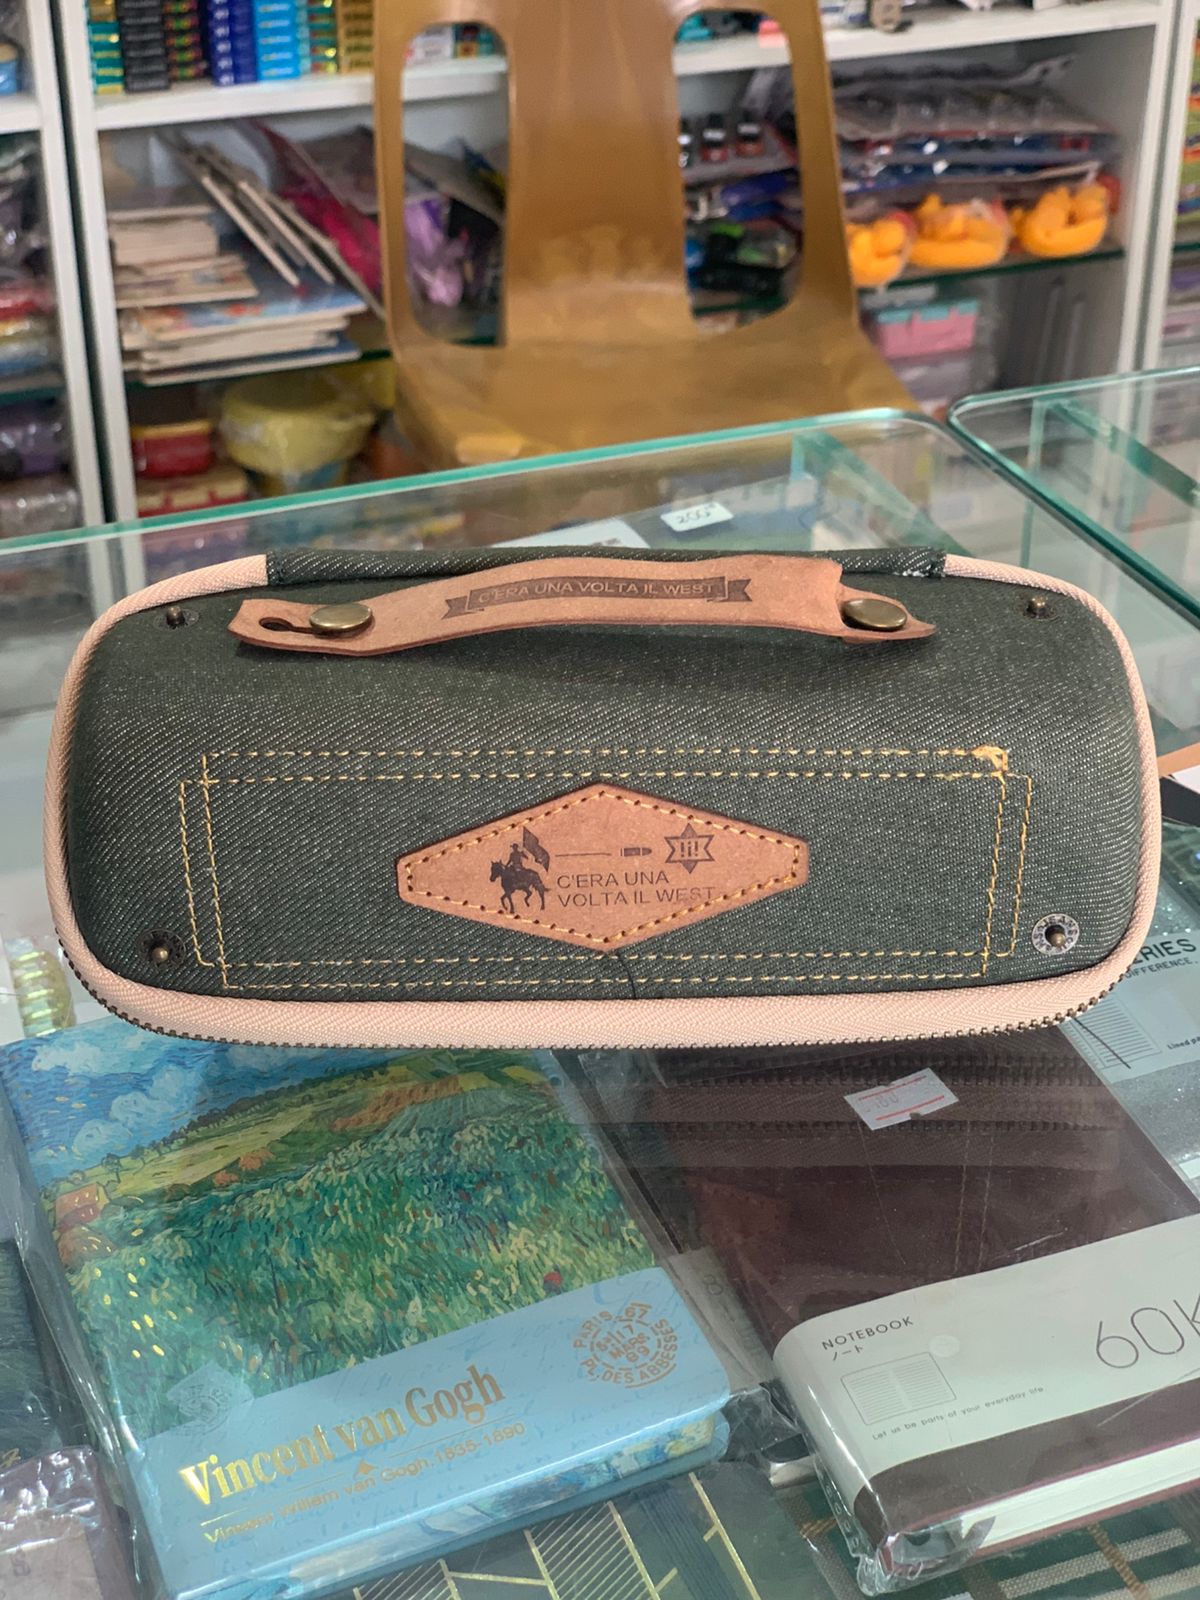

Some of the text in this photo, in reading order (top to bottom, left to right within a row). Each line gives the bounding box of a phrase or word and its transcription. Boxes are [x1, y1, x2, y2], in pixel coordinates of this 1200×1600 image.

[535, 582, 573, 595] UNA
[578, 581, 637, 594] VOLTA
[642, 583, 658, 595] IL
[663, 582, 713, 596] WEST
[557, 870, 670, 889] C'ERA UNA
[557, 886, 715, 908] VOLTA IL WEST
[821, 1316, 914, 1350] NOTEBOOK
[178, 1364, 506, 1505] Vincent van Gogh
